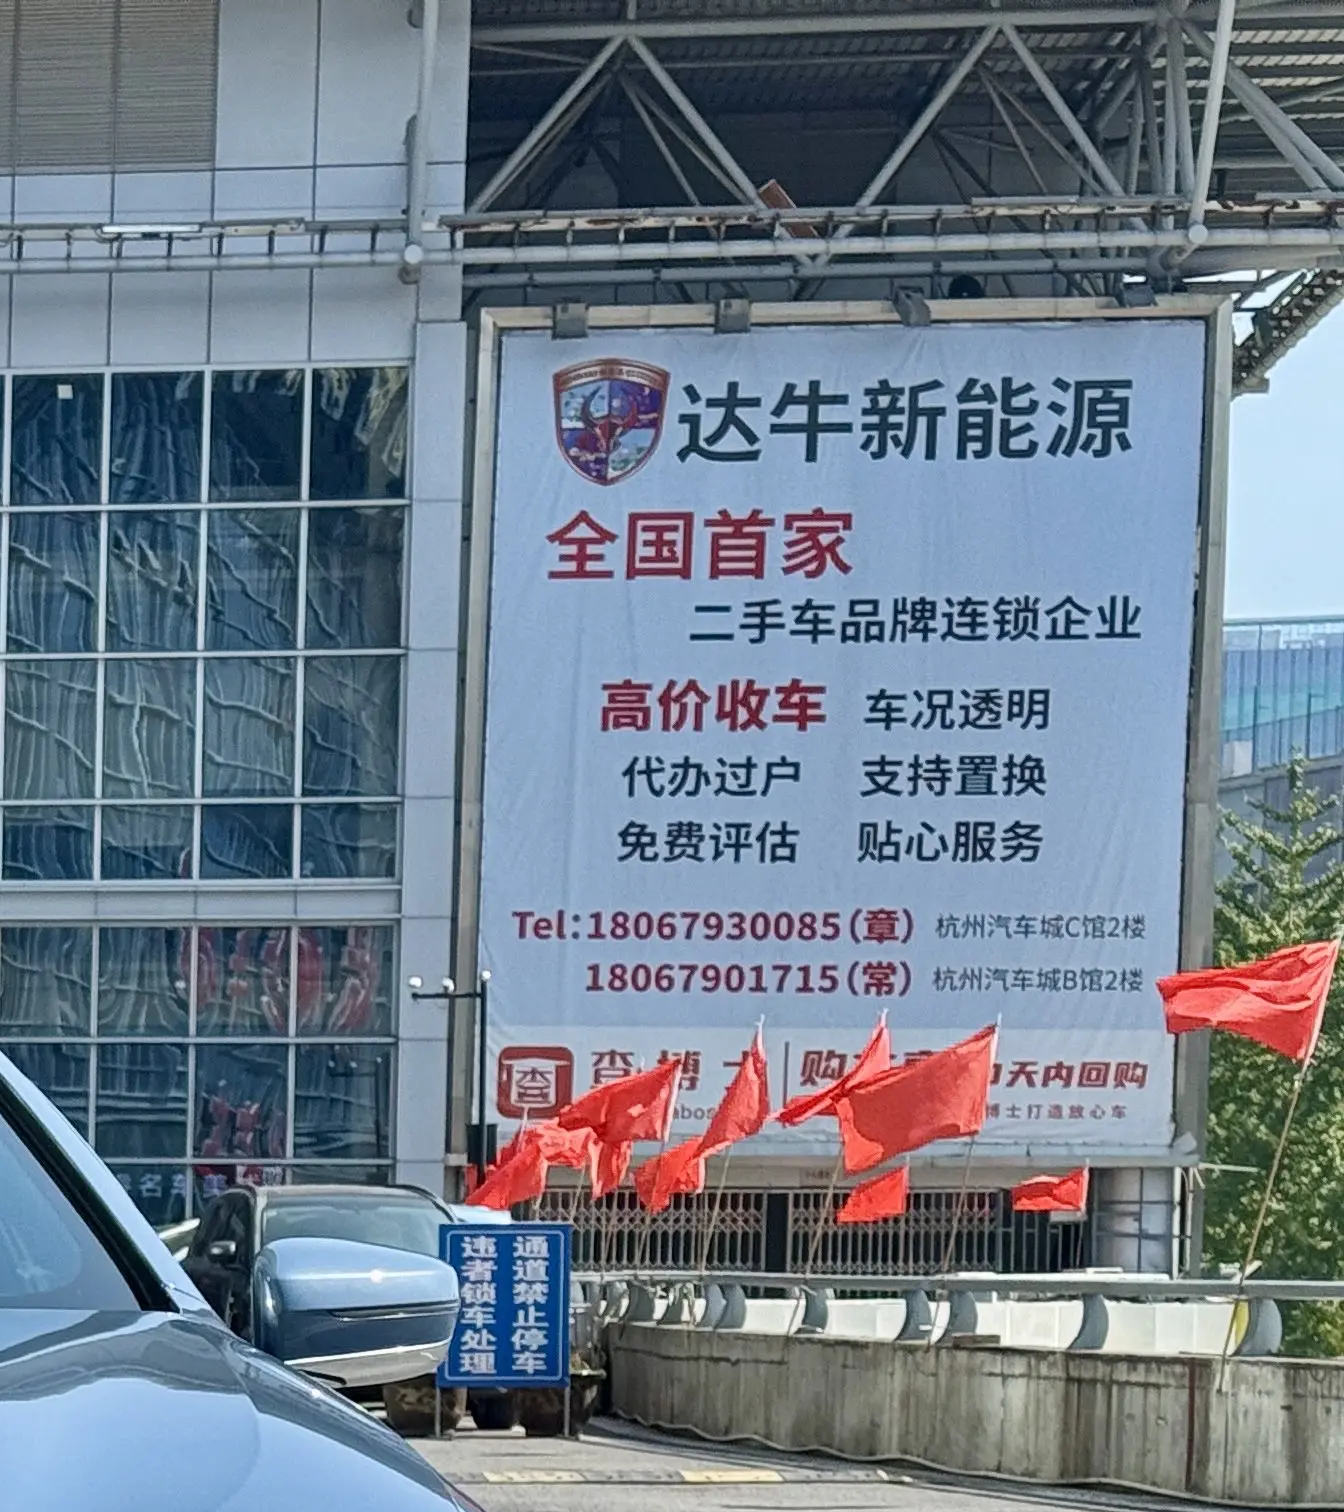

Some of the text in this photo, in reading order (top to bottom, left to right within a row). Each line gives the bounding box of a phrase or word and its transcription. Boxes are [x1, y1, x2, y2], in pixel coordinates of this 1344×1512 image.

[675, 376, 1134, 463] 达牛新能源
[545, 507, 854, 582] 全国首家
[689, 594, 1143, 645] 二手车品牌连锁企业
[600, 677, 1052, 733] 高价收车 车况透明
[621, 752, 1049, 799] 代办过户 支持置换
[616, 818, 1044, 864] 免费评估 贴心服务
[934, 912, 1147, 940] 杭州汽车城C馆2楼
[931, 964, 1144, 993] 杭州汽车城B馆2楼
[459, 1235, 498, 1376] 违者锁车处理
[510, 1235, 550, 1376] 通道禁止停车
